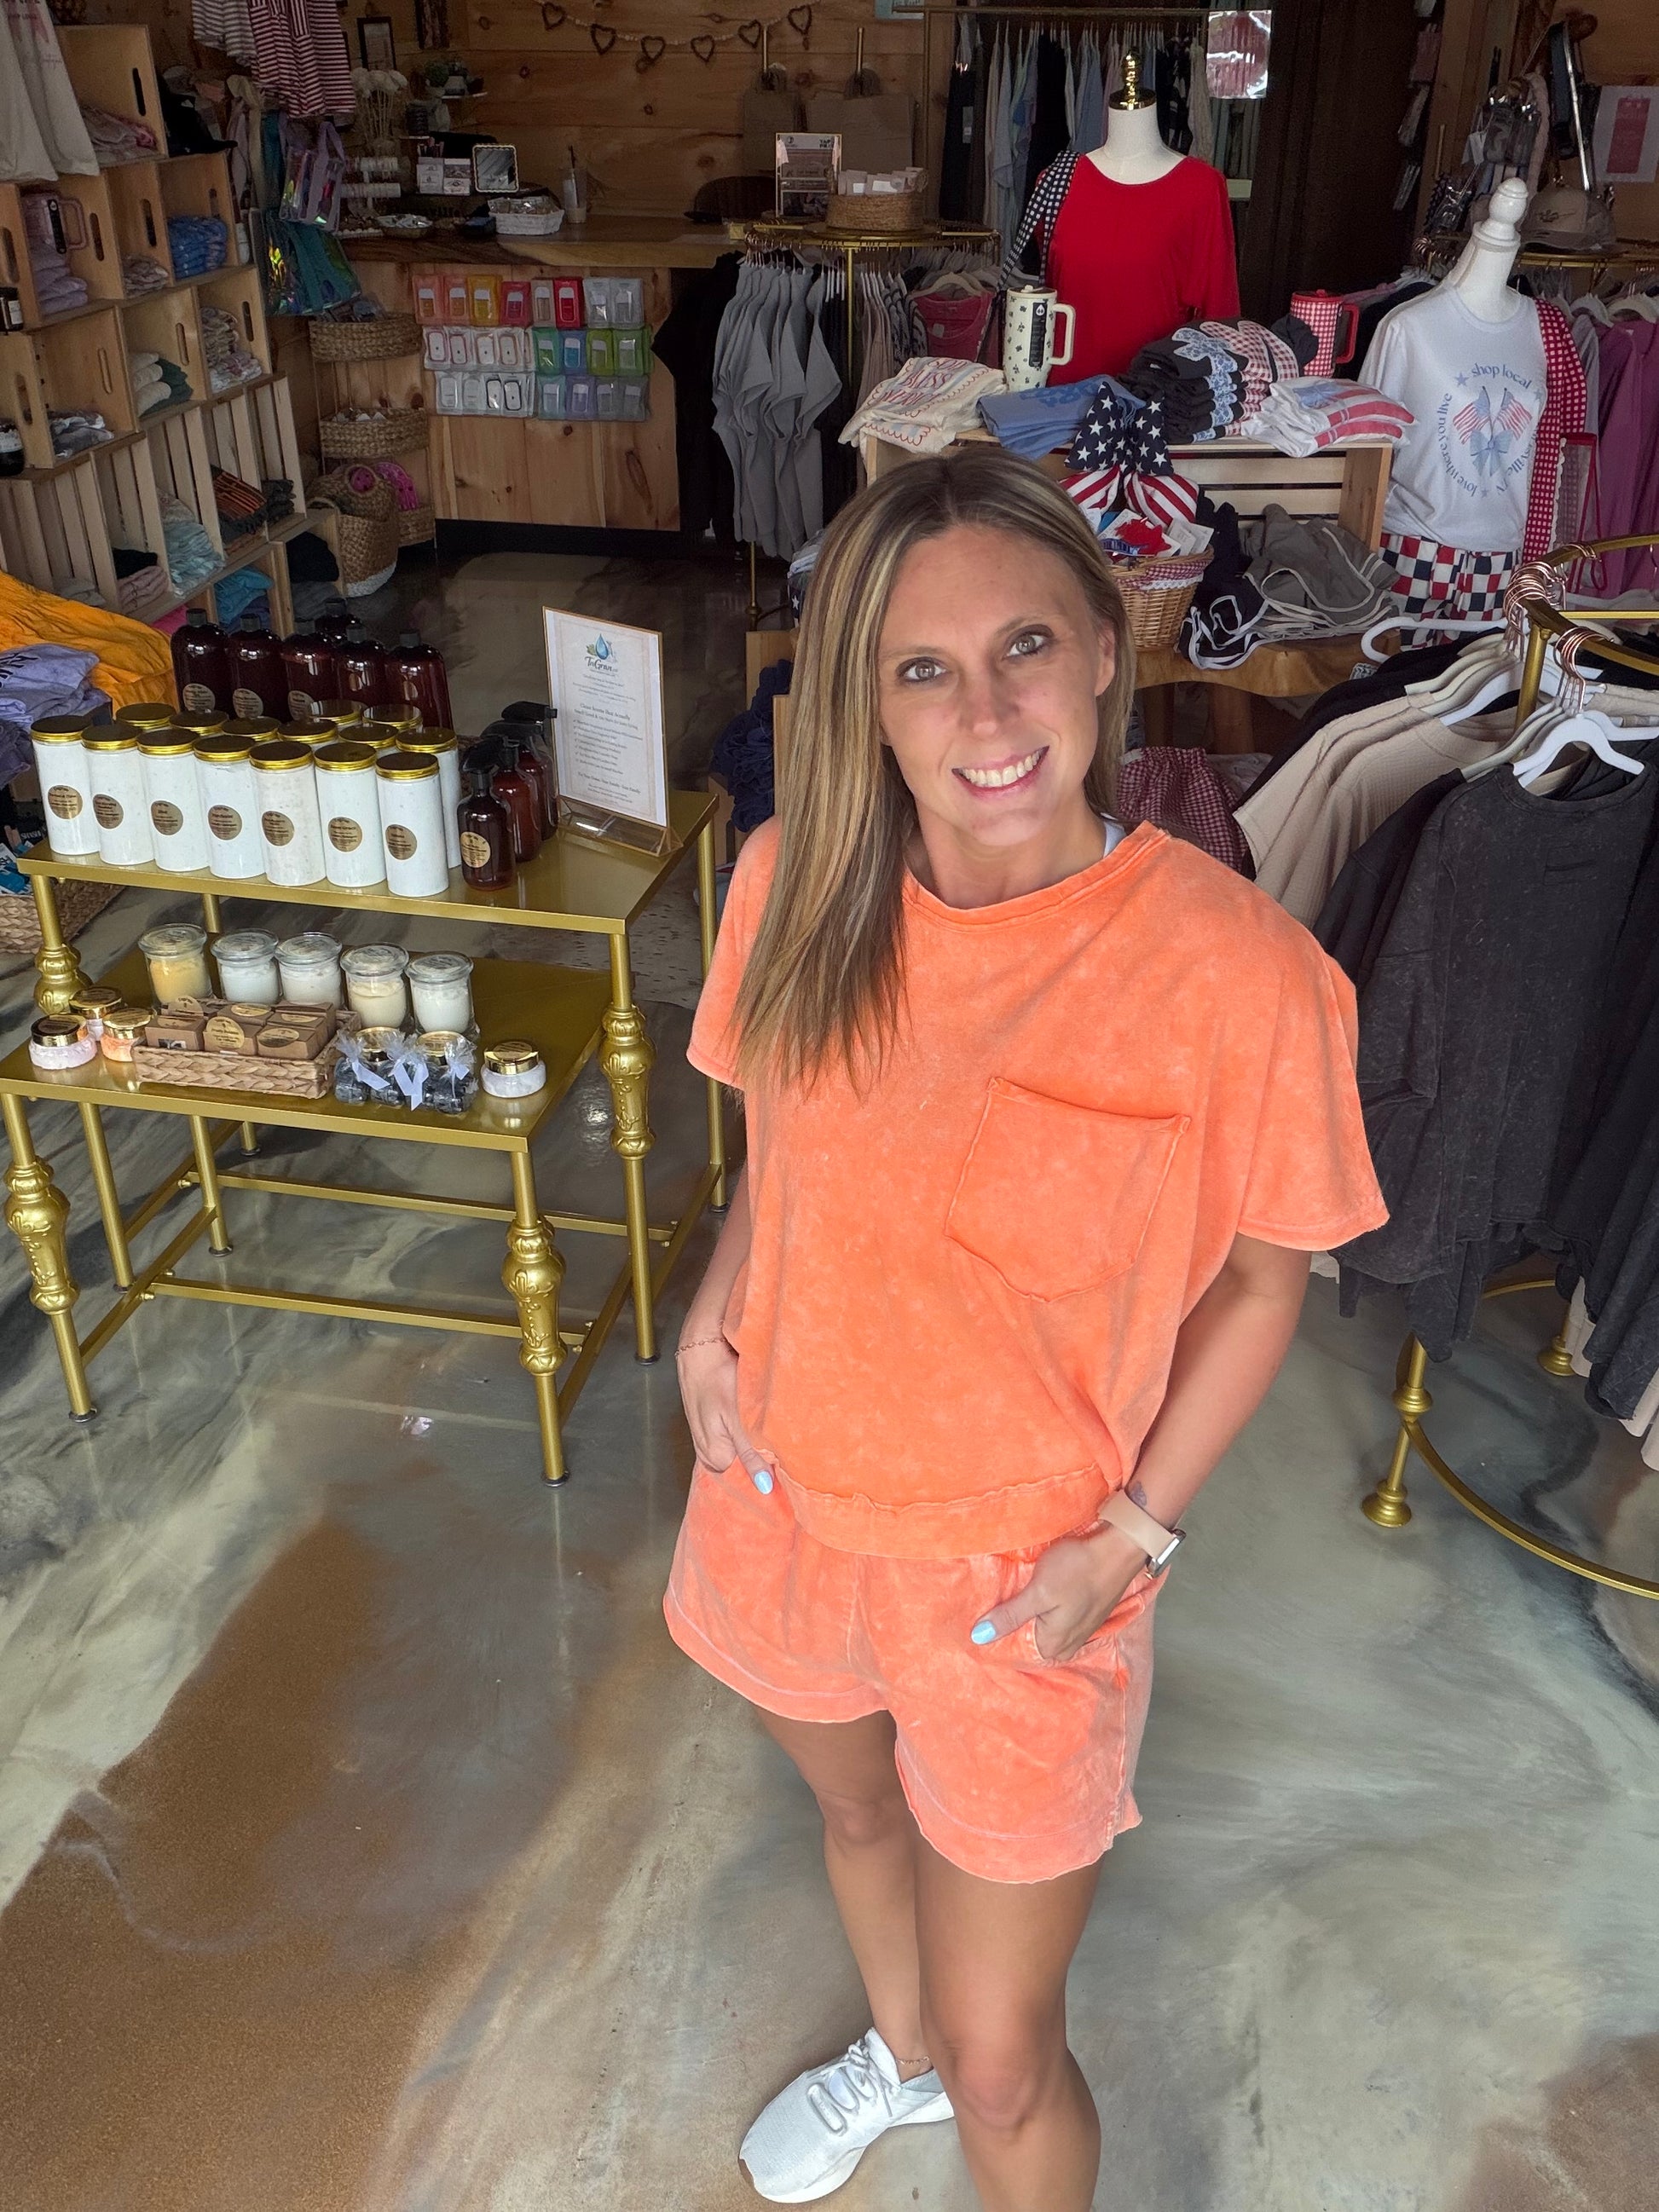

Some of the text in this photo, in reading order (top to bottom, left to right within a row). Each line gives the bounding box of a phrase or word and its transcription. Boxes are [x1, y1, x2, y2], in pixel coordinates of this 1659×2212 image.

[1471, 362, 1532, 390] shop local
[1436, 393, 1477, 497] love where you live
